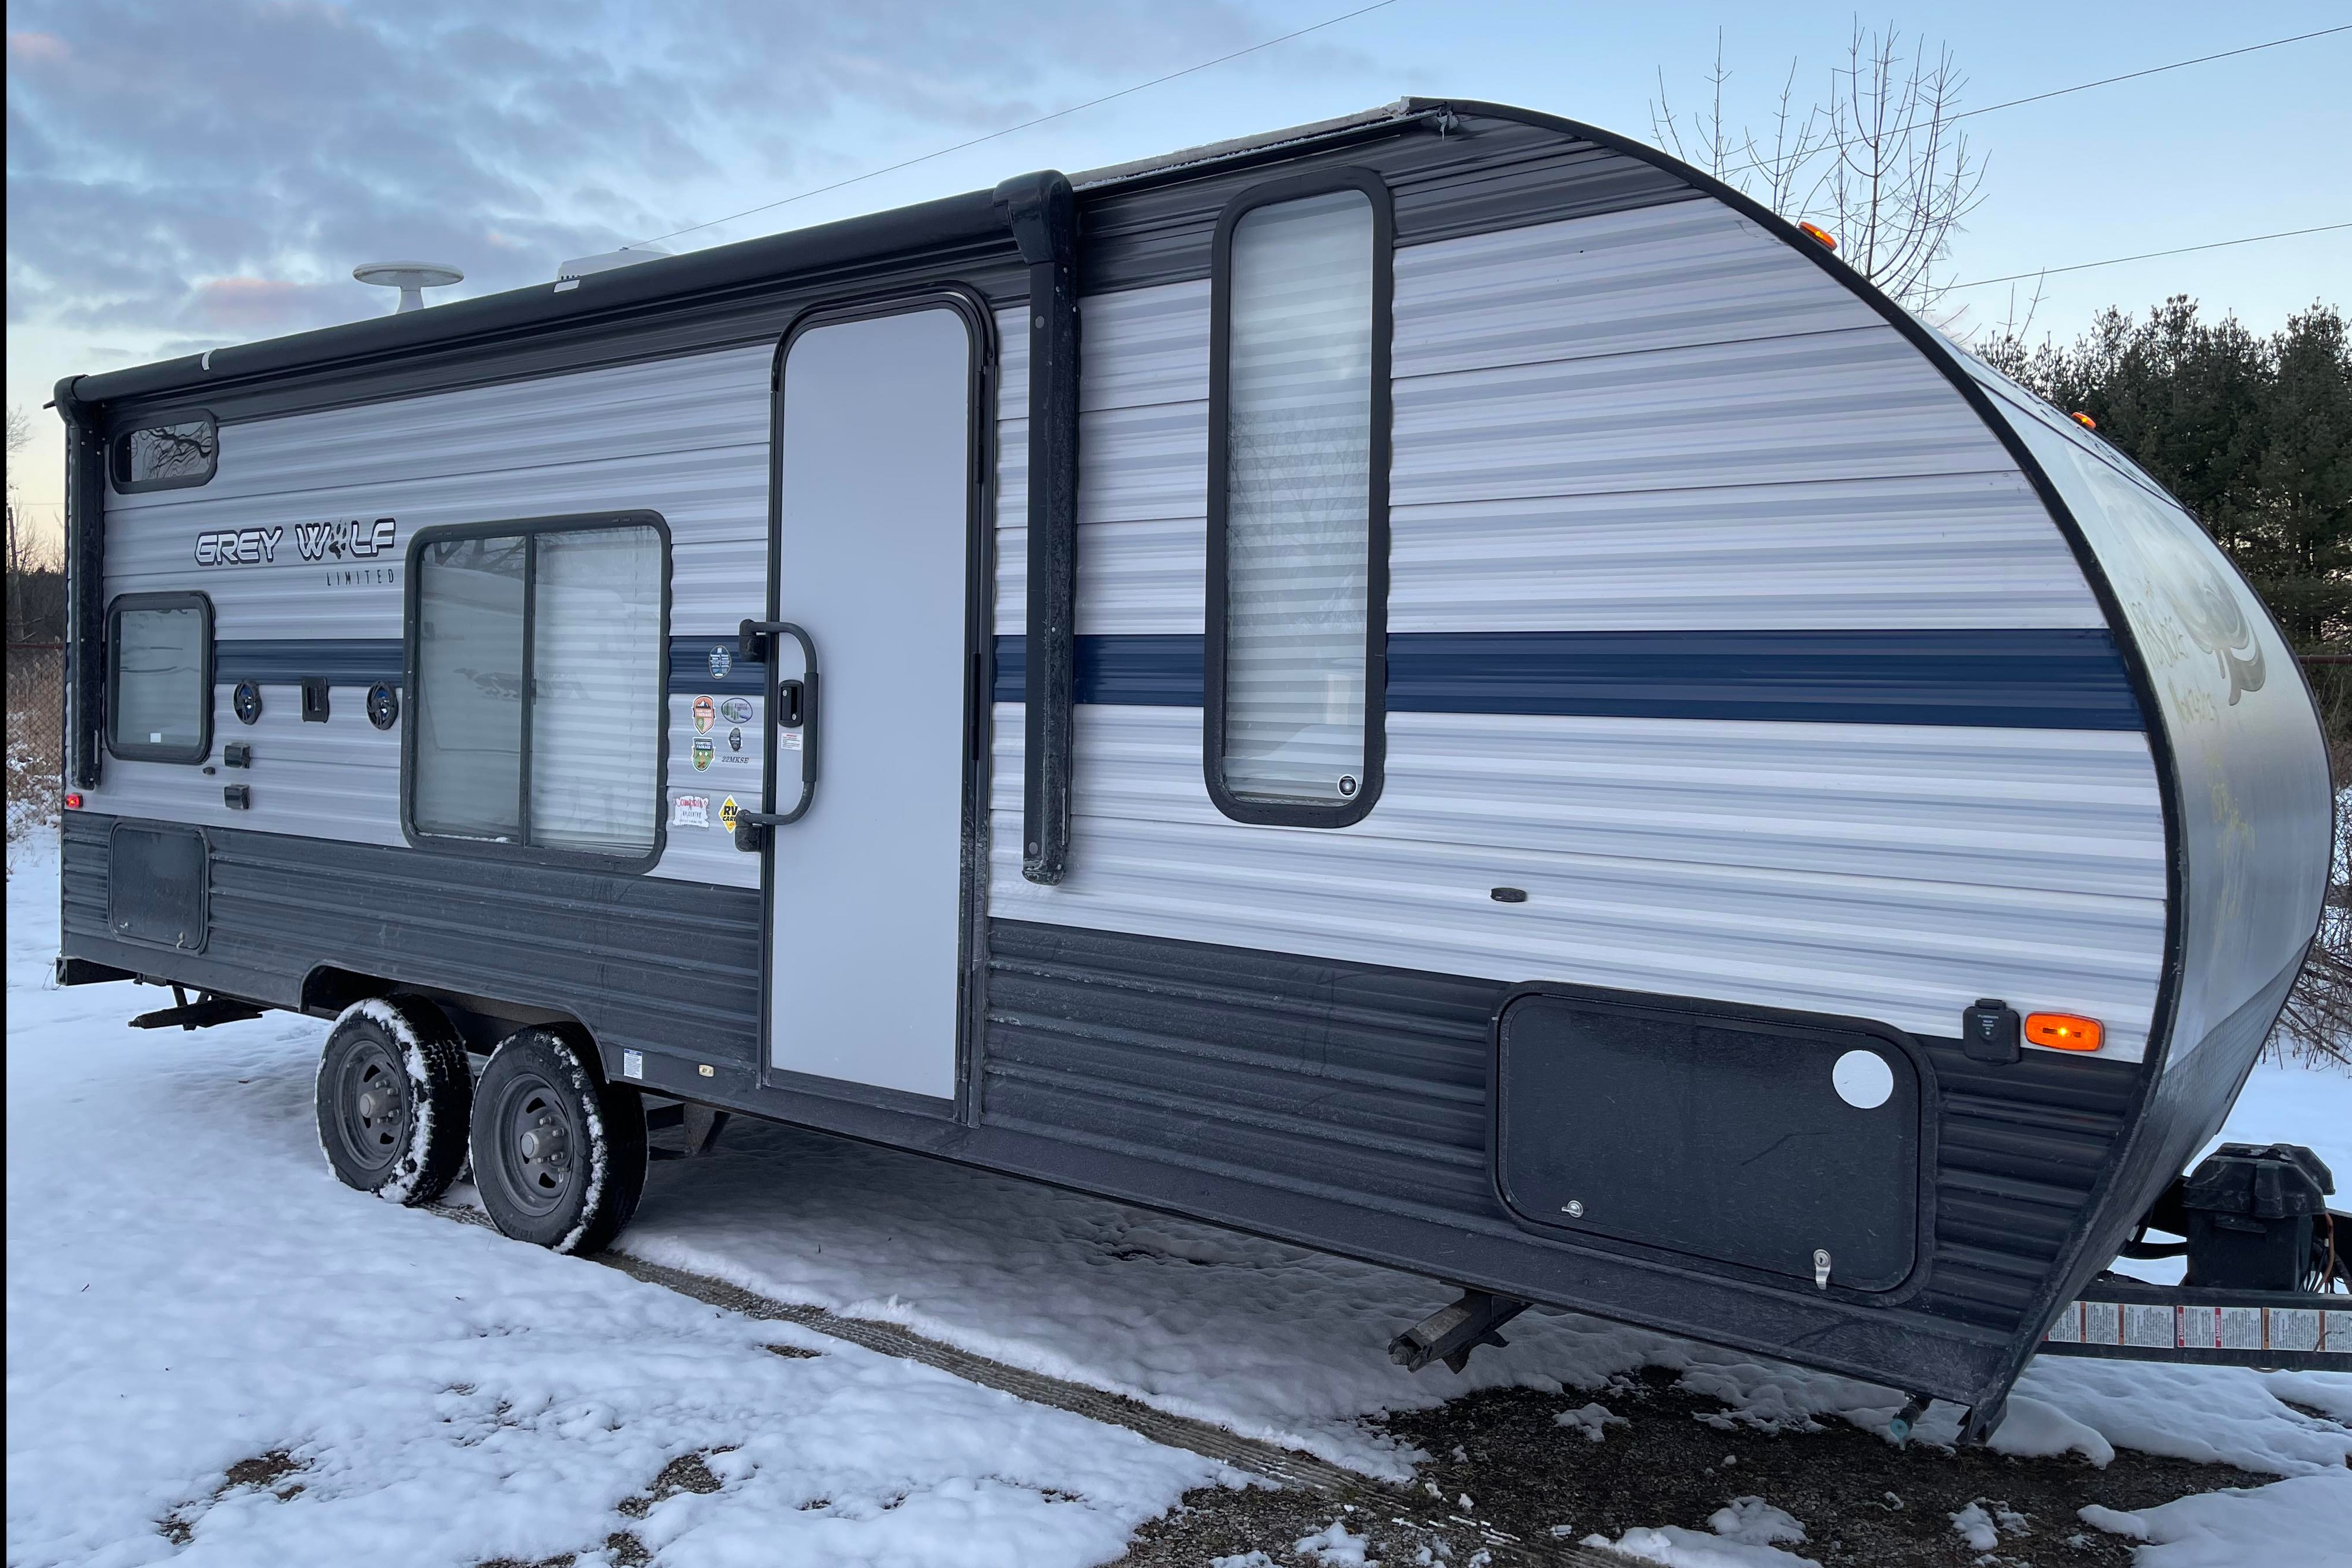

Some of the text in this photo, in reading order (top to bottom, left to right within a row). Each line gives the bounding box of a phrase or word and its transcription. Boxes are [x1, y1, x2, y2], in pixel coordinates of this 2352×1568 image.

[194, 526, 284, 566] GREY
[326, 569, 394, 586] LIMITED
[722, 756, 750, 764] 22MKSE
[723, 806, 738, 816] RV
